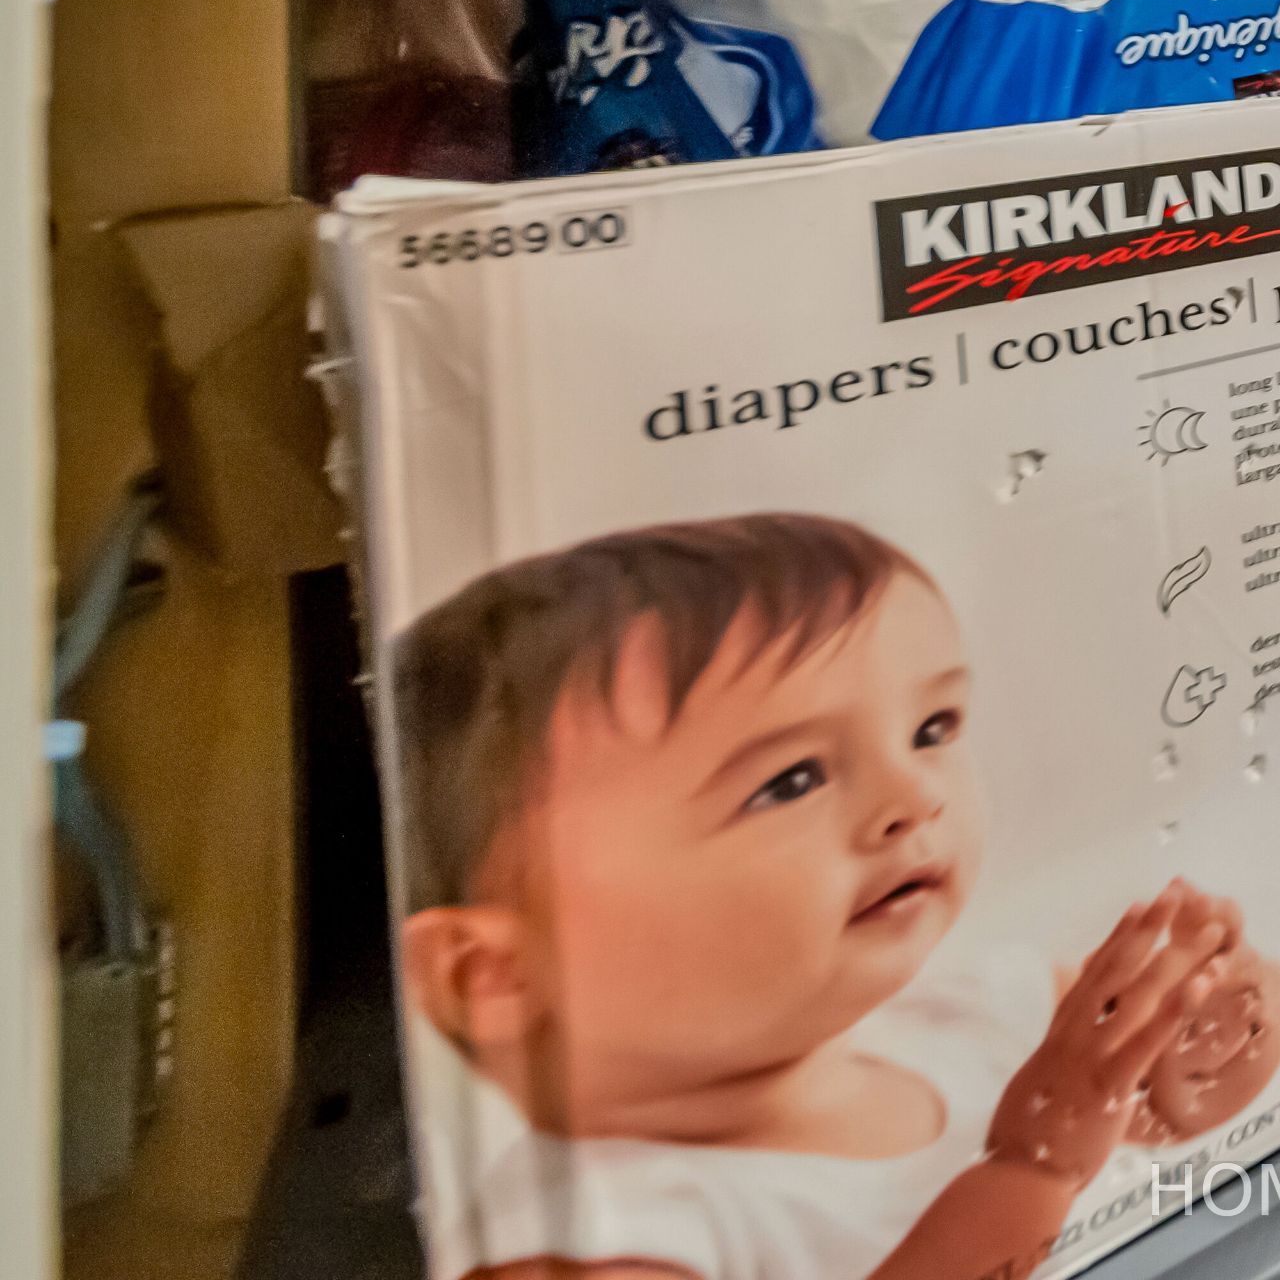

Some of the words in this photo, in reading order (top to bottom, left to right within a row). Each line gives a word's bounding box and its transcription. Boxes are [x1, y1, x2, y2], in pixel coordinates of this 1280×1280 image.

[643, 353, 937, 443] diapers
[992, 289, 1231, 373] couches
[1229, 374, 1273, 399] long
[1230, 401, 1269, 422] une
